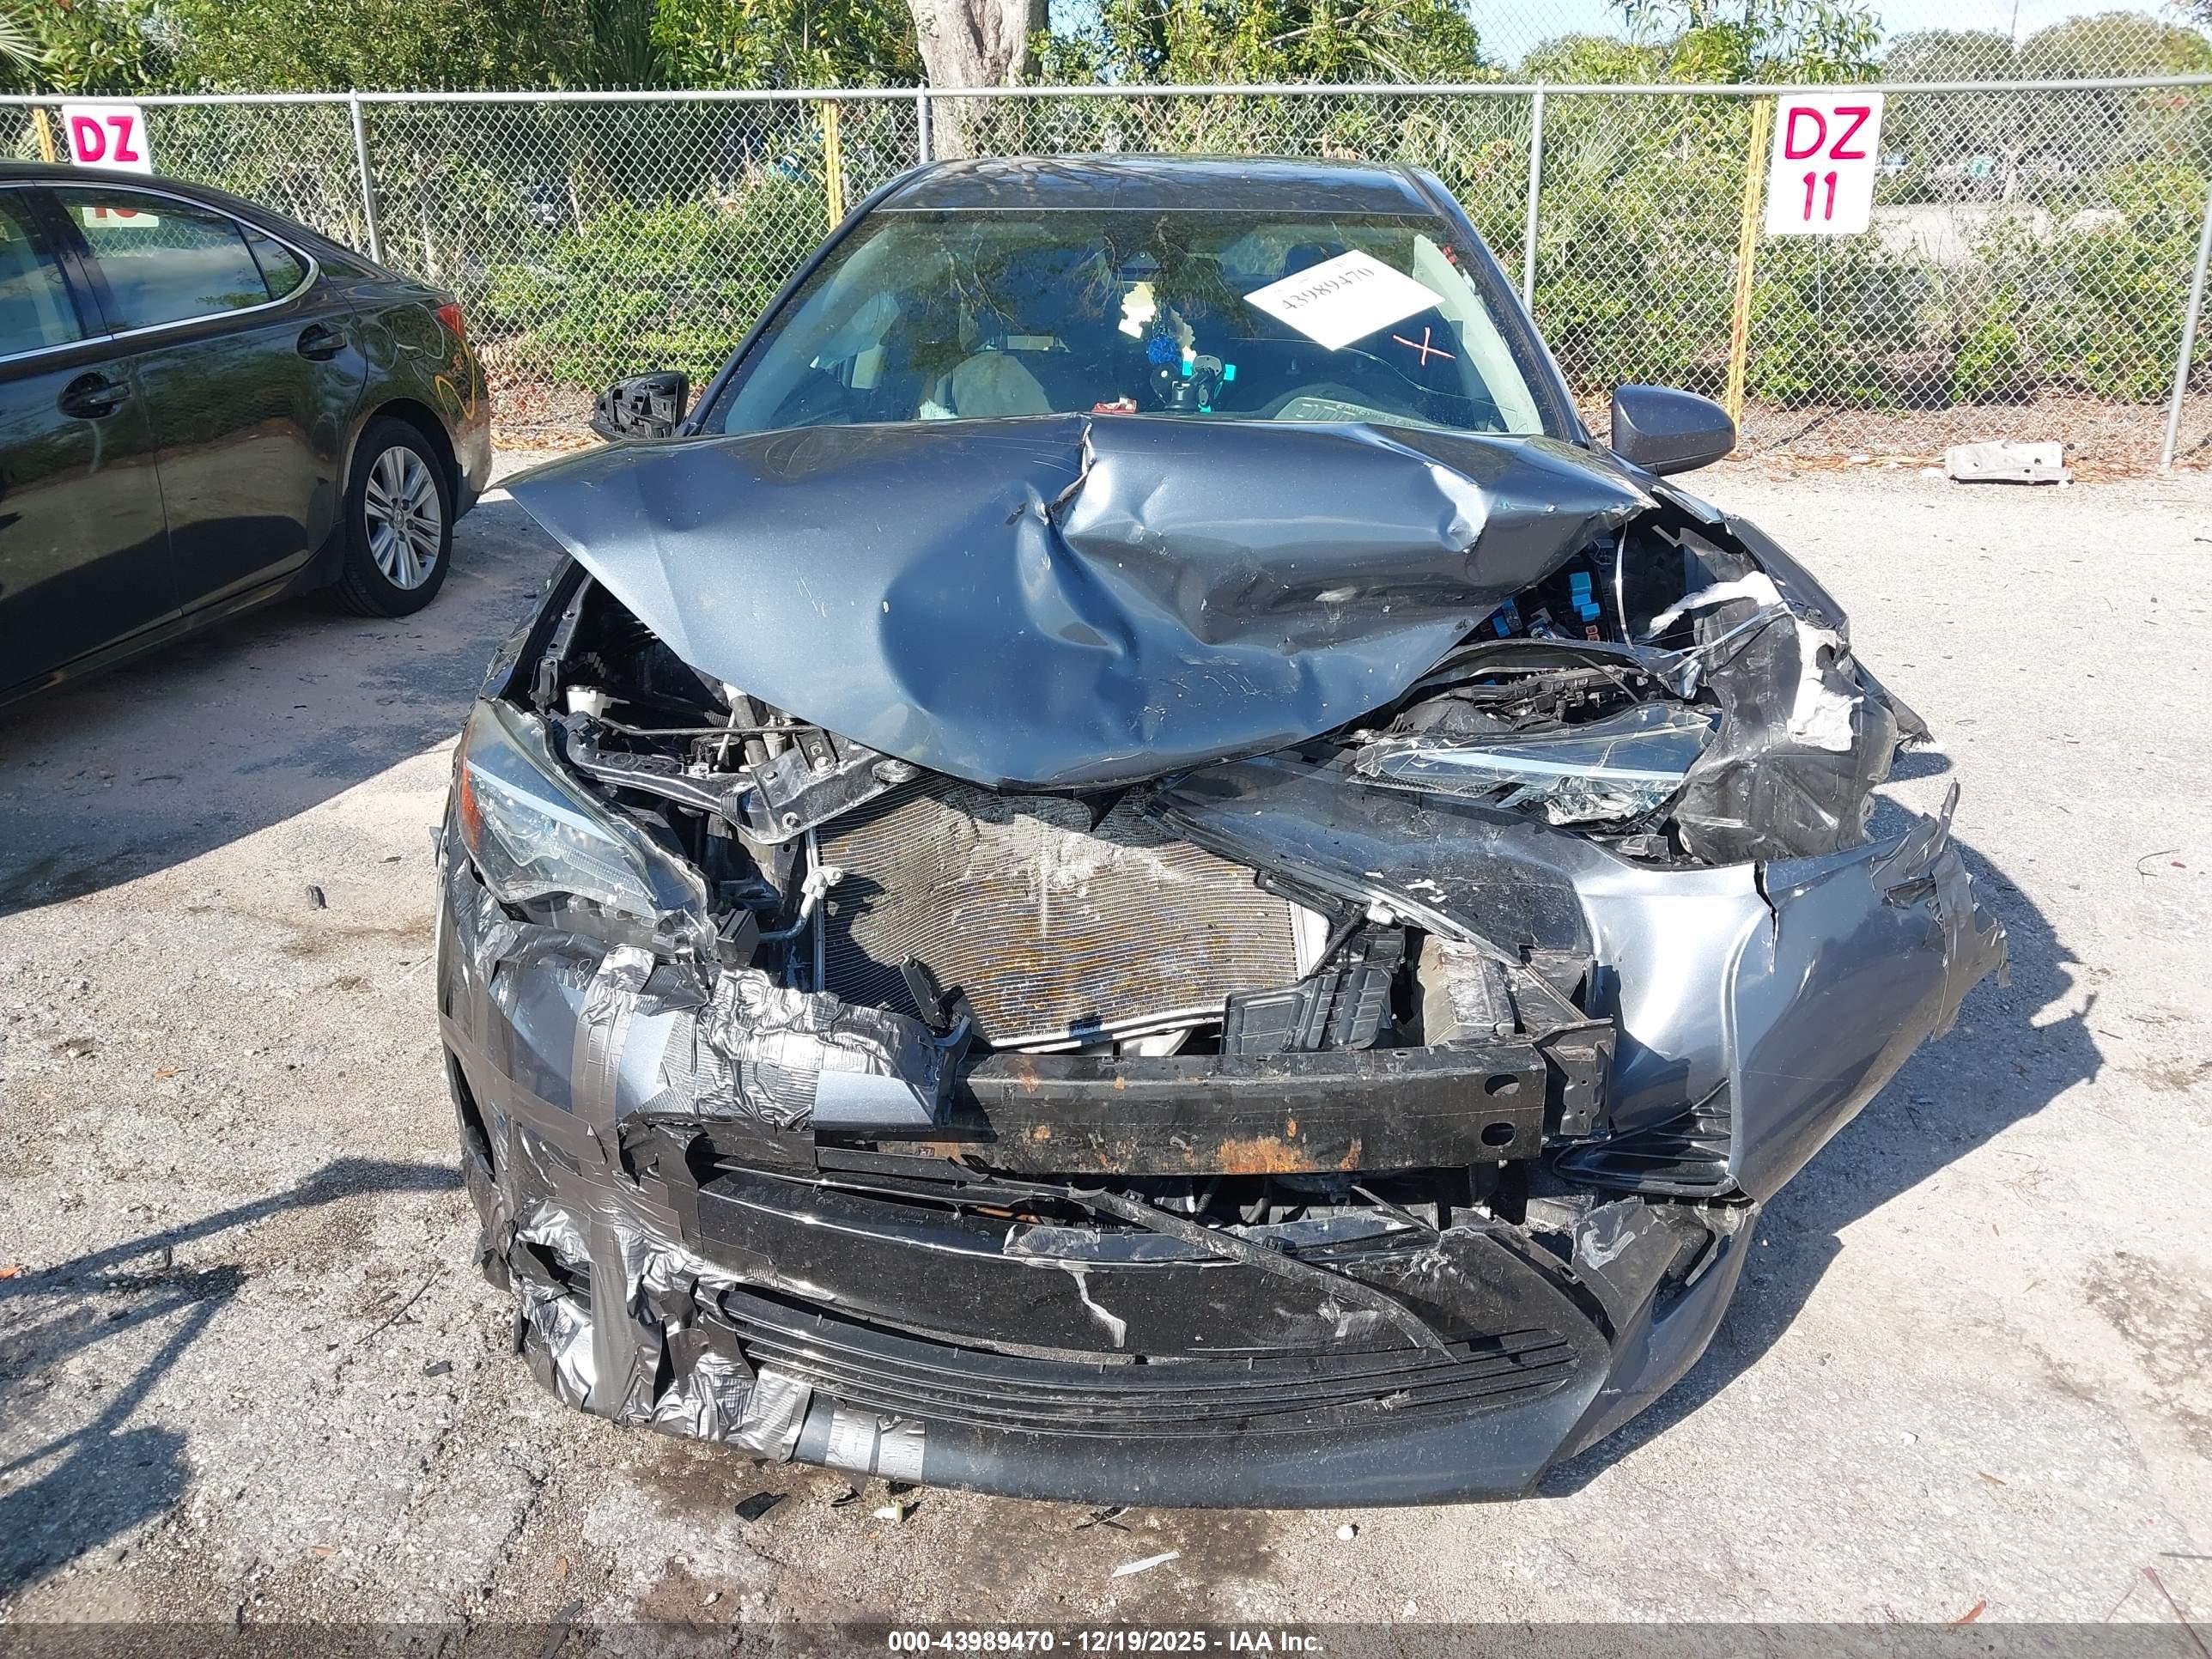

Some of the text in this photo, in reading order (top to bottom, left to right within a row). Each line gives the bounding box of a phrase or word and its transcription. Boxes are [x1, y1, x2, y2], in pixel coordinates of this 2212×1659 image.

[71, 116, 139, 162] DZ
[1784, 106, 1871, 161] DZ
[1802, 171, 1838, 222] 11
[1282, 267, 1375, 310] 43989470
